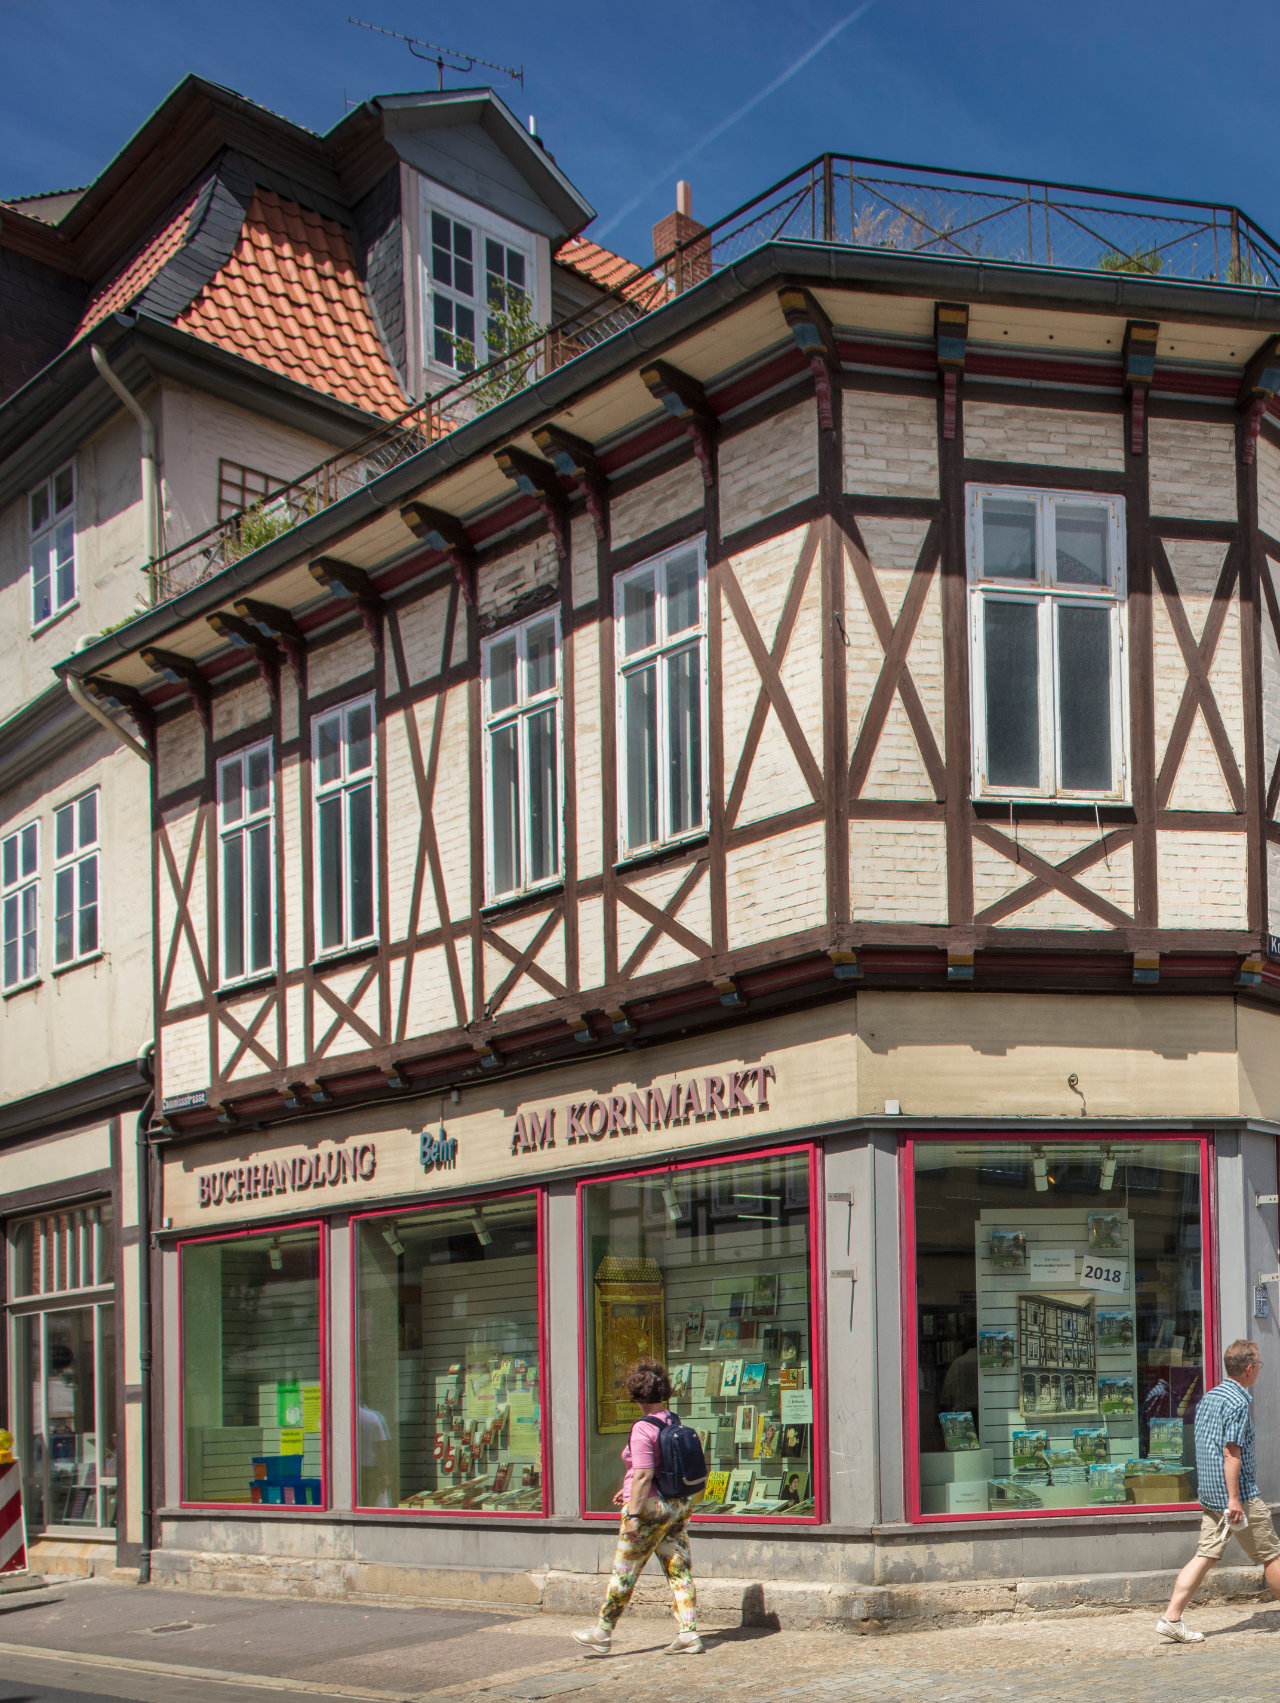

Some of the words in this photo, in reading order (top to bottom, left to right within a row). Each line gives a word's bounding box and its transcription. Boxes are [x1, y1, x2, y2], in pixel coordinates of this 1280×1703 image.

[198, 1144, 376, 1205] BUCHHANDLUNG
[419, 1129, 458, 1168] Behr
[509, 1108, 556, 1149] AM
[565, 1064, 776, 1140] KORNMARKT
[1085, 1265, 1121, 1283] 2018
